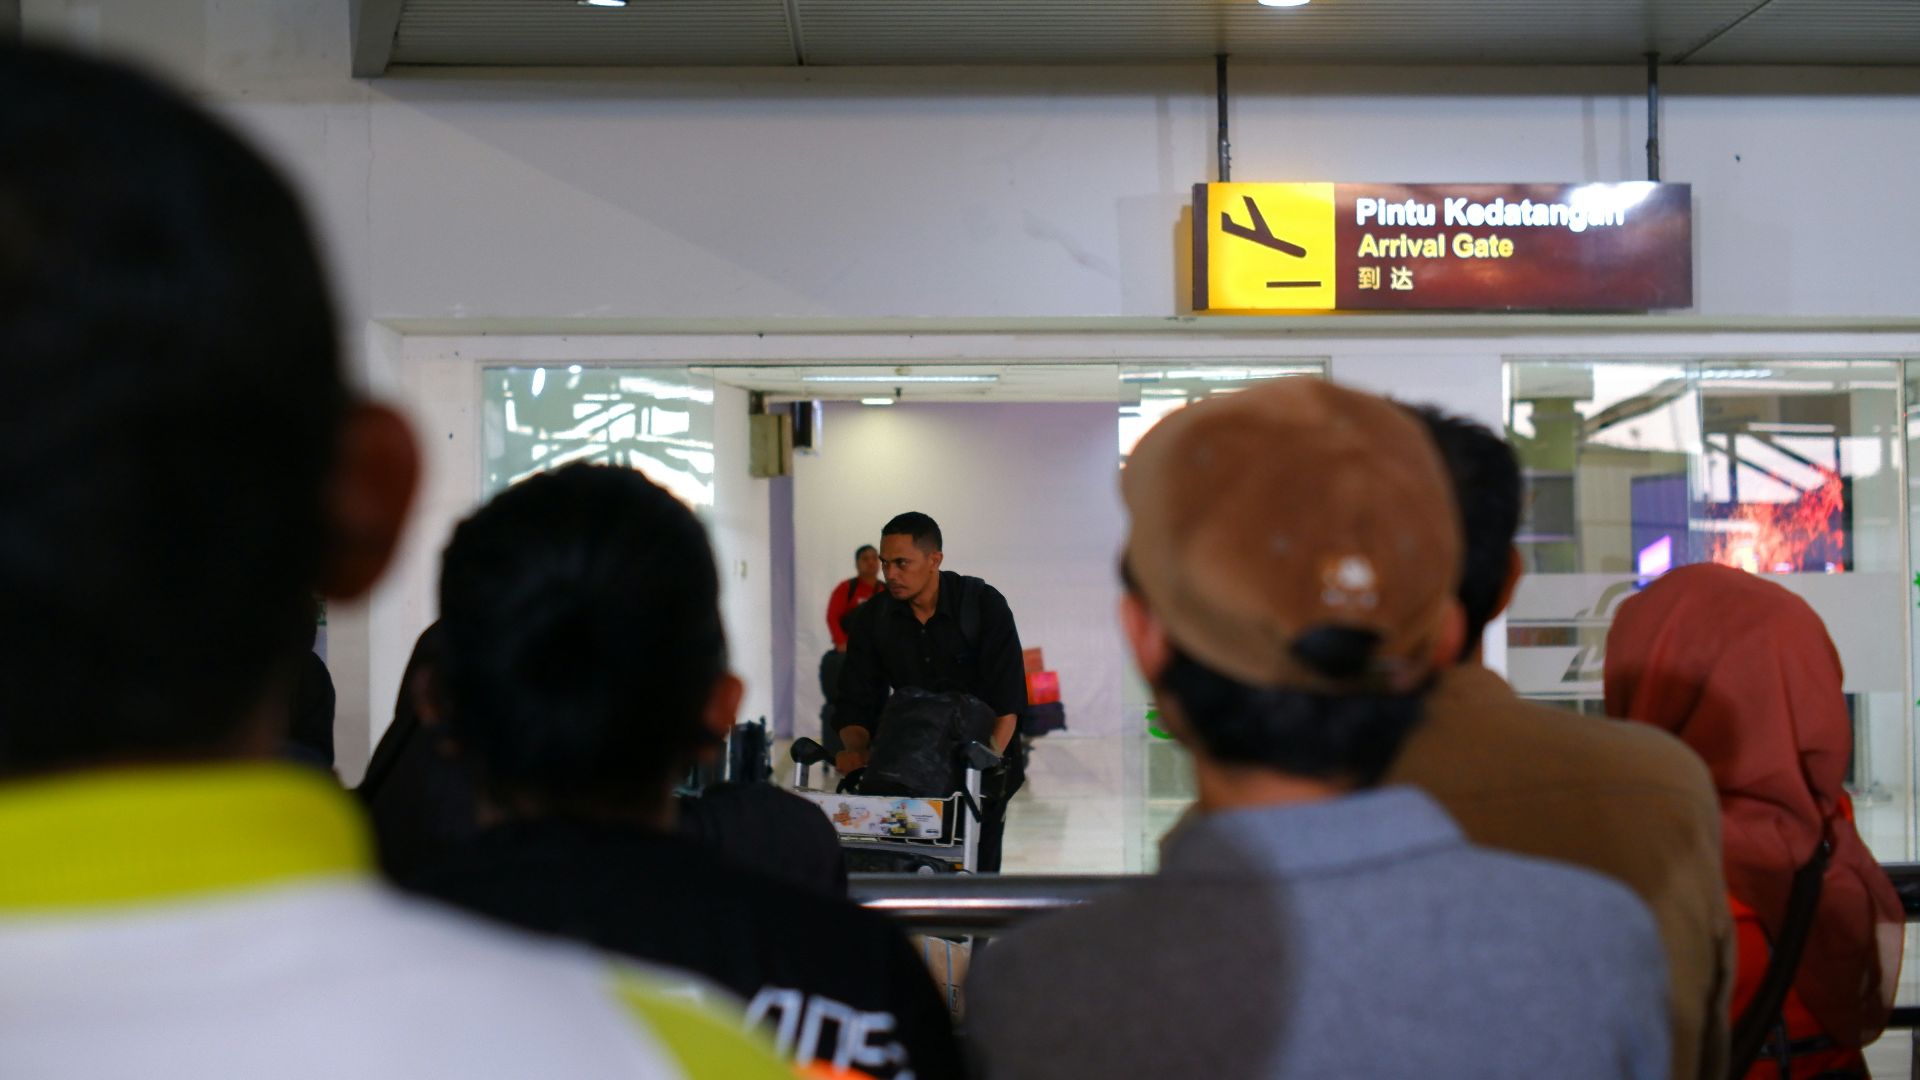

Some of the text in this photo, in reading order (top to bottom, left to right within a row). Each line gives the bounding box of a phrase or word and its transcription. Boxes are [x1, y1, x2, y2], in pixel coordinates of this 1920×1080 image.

[1356, 198, 1625, 232] Pintu Kedatangan
[1358, 233, 1514, 258] Arrival Gate
